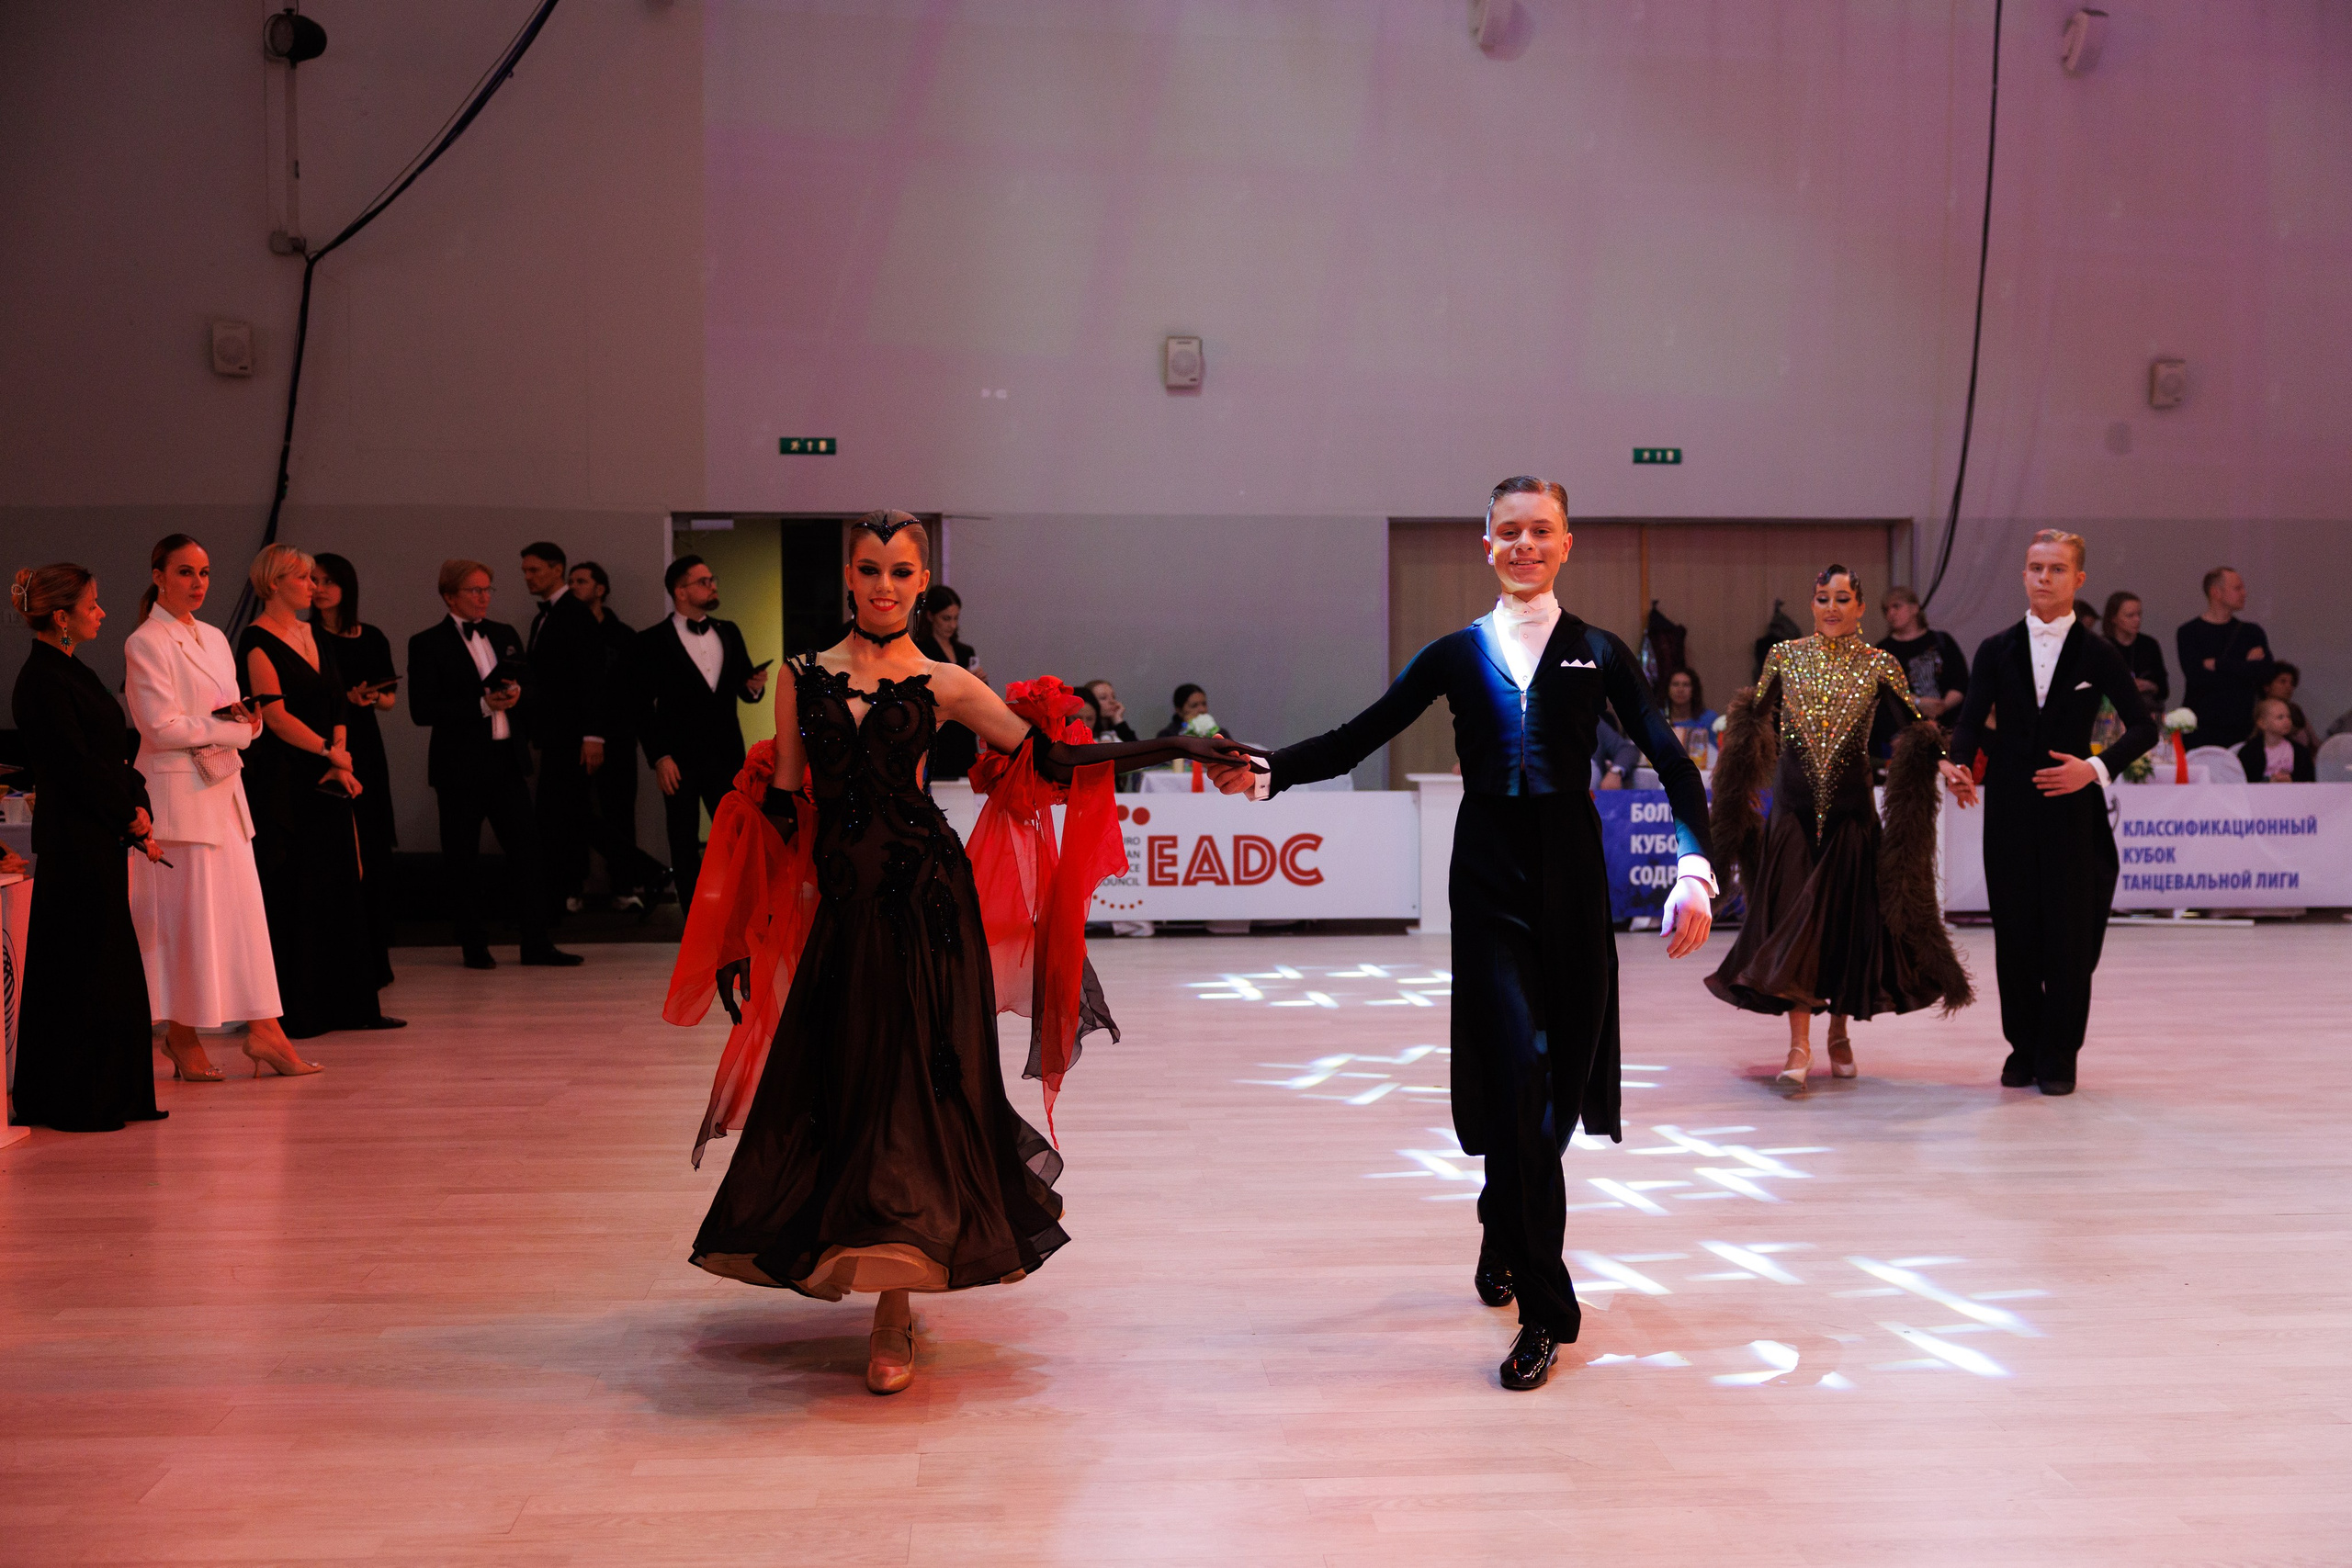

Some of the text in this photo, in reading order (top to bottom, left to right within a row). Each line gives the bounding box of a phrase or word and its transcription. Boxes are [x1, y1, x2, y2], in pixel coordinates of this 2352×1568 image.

[2123, 815, 2317, 838] КЛАССИФИКАЦИОННЫЙ
[1148, 833, 1324, 886] EADC
[2123, 847, 2176, 863] КУБОК
[2123, 870, 2299, 894] ТАНЦЕВАЛЬНОЙ ЛИГИ
